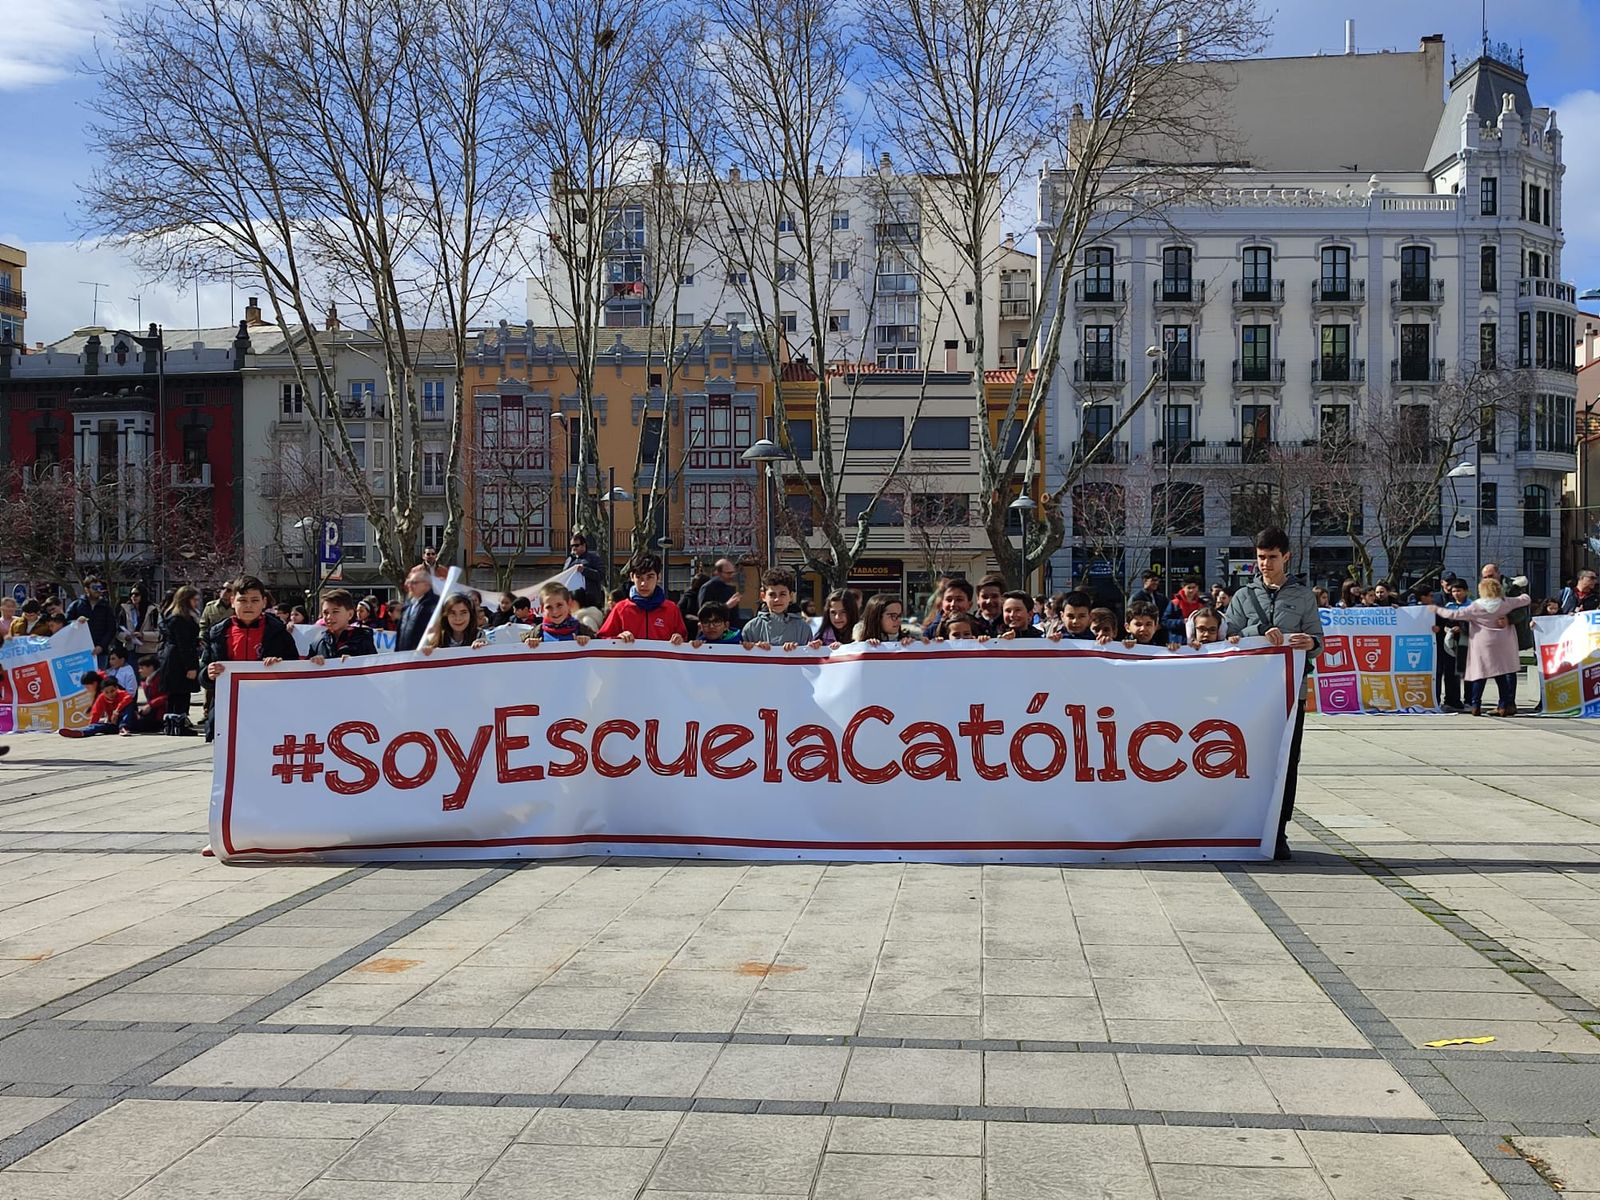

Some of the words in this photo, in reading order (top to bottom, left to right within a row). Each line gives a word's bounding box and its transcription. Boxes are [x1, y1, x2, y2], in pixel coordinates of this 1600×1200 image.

[325, 521, 338, 558] P
[1344, 608, 1397, 616] DESARROLLO
[1333, 616, 1397, 625] SOSTENIBLE
[1320, 679, 1329, 688] 10
[272, 692, 1250, 811] #SoyEscuelaCatólica
